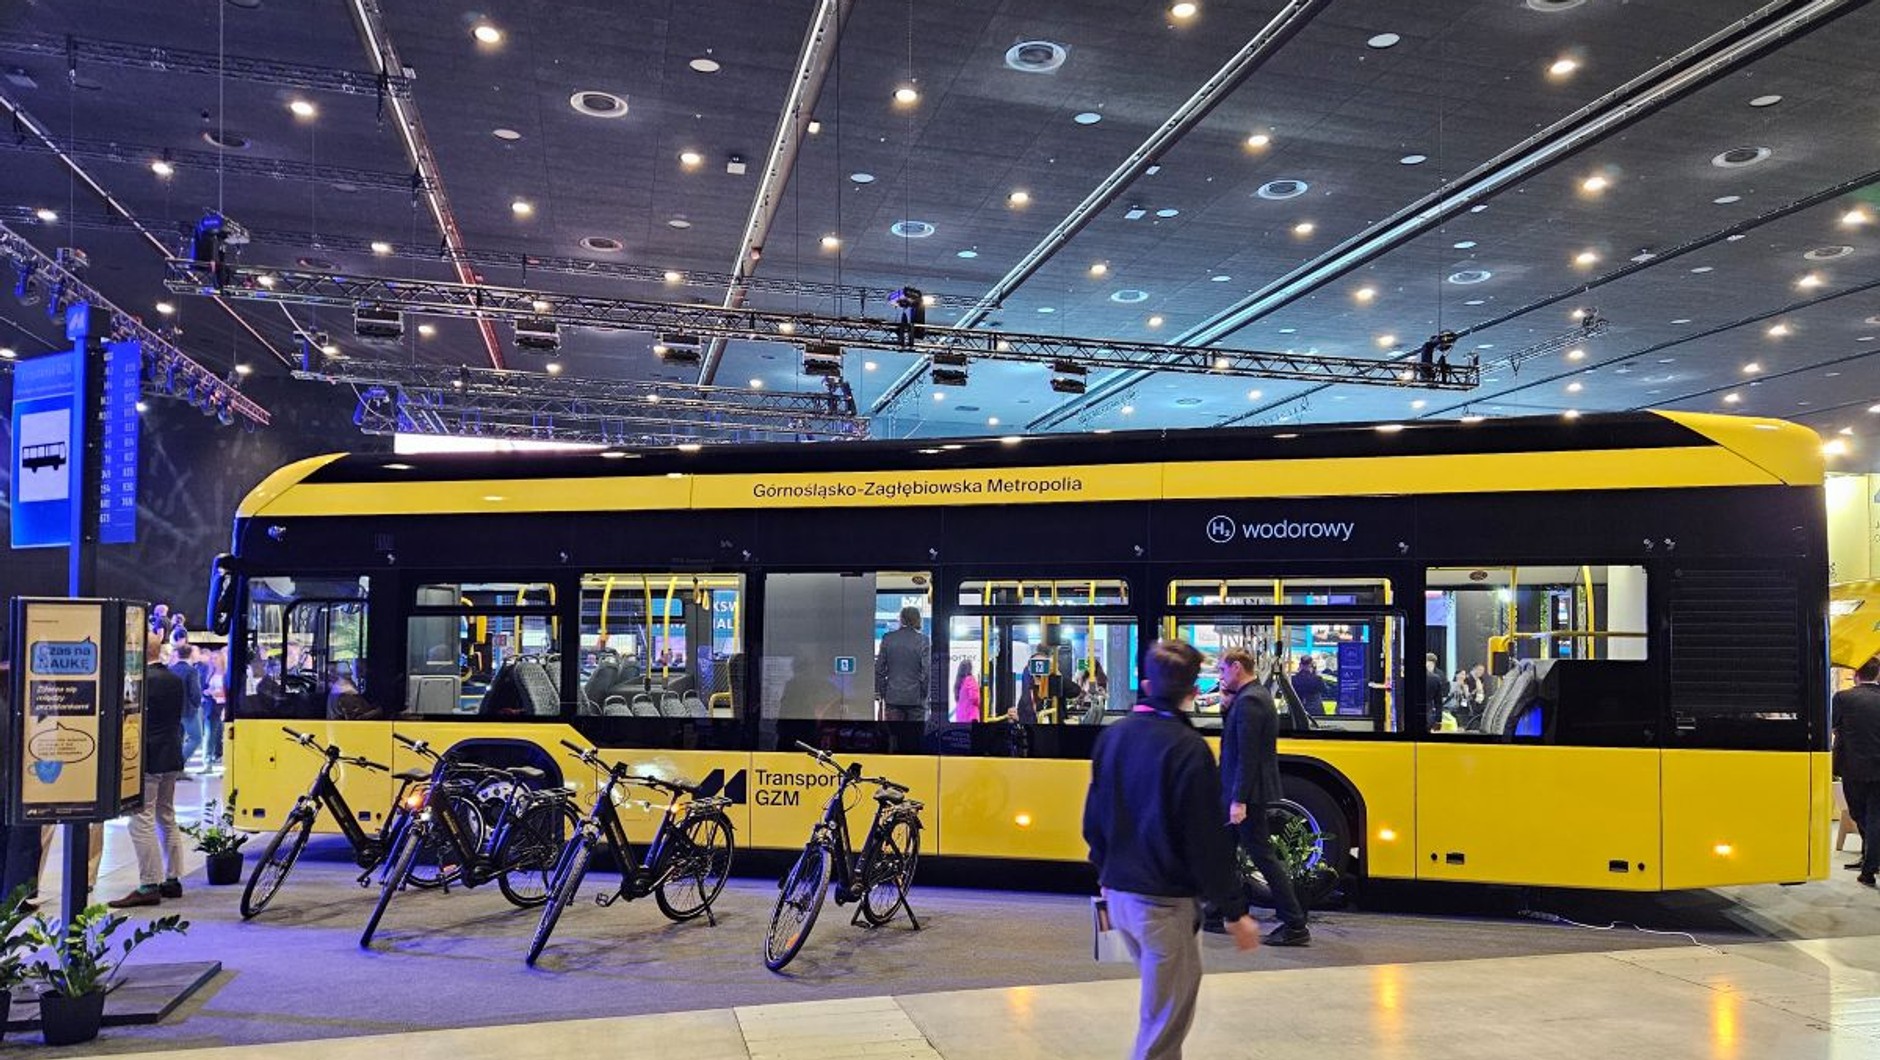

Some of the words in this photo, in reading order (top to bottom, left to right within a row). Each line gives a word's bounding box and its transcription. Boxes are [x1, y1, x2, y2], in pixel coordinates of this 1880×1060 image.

[753, 482, 982, 498] Górnośląsko-Zagłębiowska
[987, 477, 1082, 493] Metropolia
[1242, 519, 1355, 542] wodorowy
[39, 645, 71, 656] Czas
[74, 647, 91, 656] na
[755, 790, 799, 806] GZM
